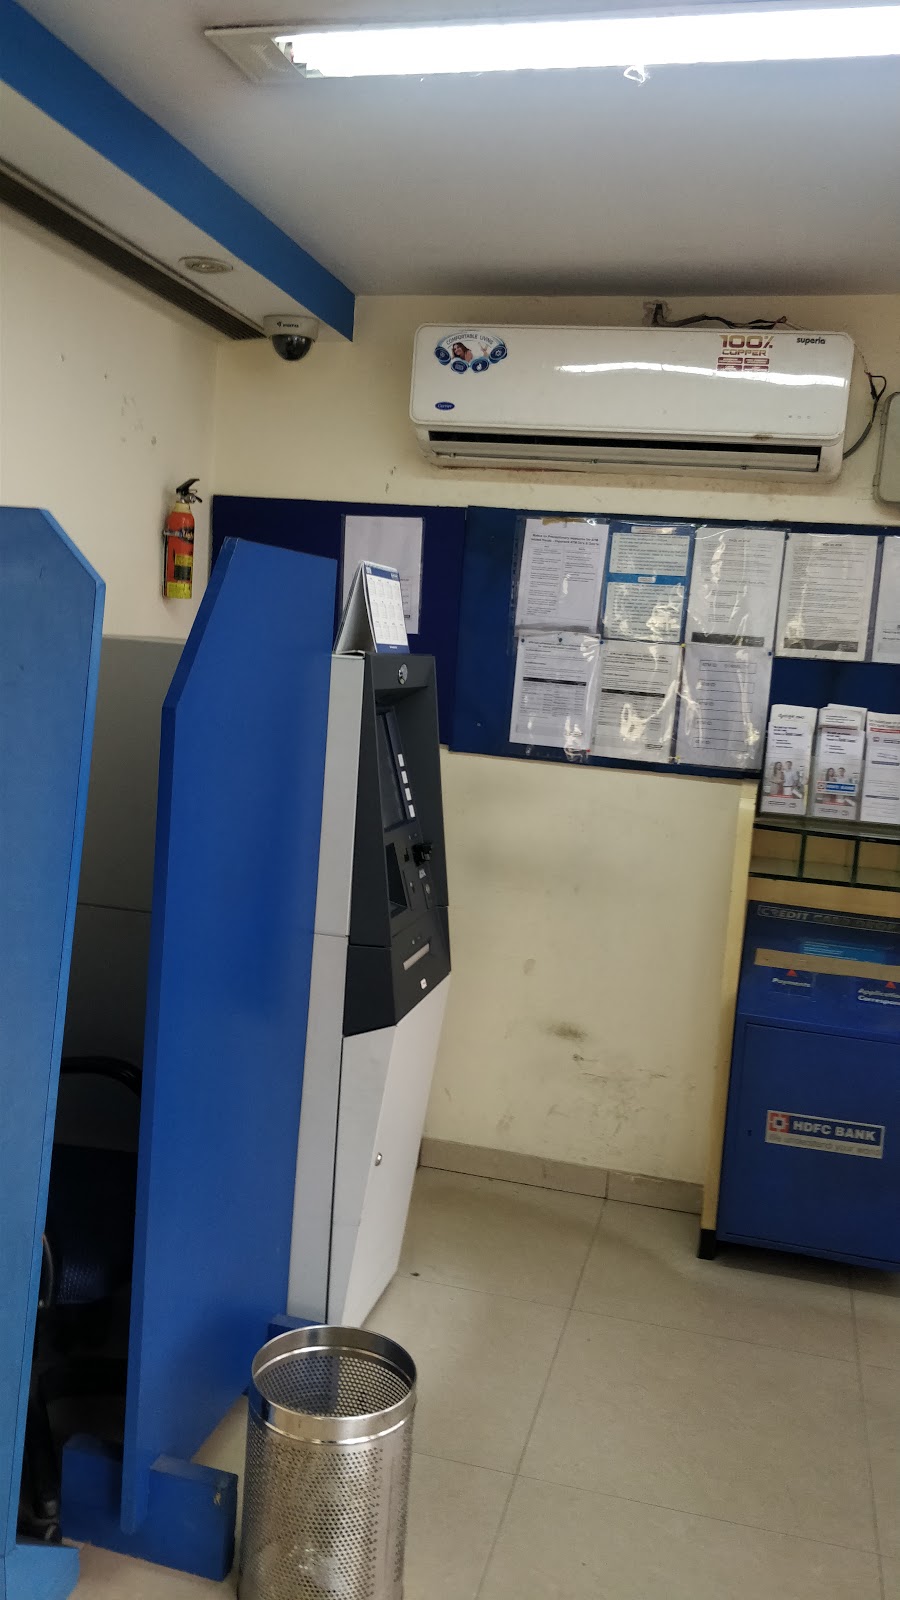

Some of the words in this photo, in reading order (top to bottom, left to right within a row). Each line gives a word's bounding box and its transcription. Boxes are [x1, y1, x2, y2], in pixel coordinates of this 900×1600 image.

[446, 334, 478, 345] COMFORTABLE
[480, 336, 494, 345] LIVING
[719, 334, 774, 348] 100%
[796, 337, 826, 345] superia
[762, 906, 808, 920] CREDIT
[793, 1120, 831, 1135] HDFC
[834, 1126, 876, 1141] BANK
